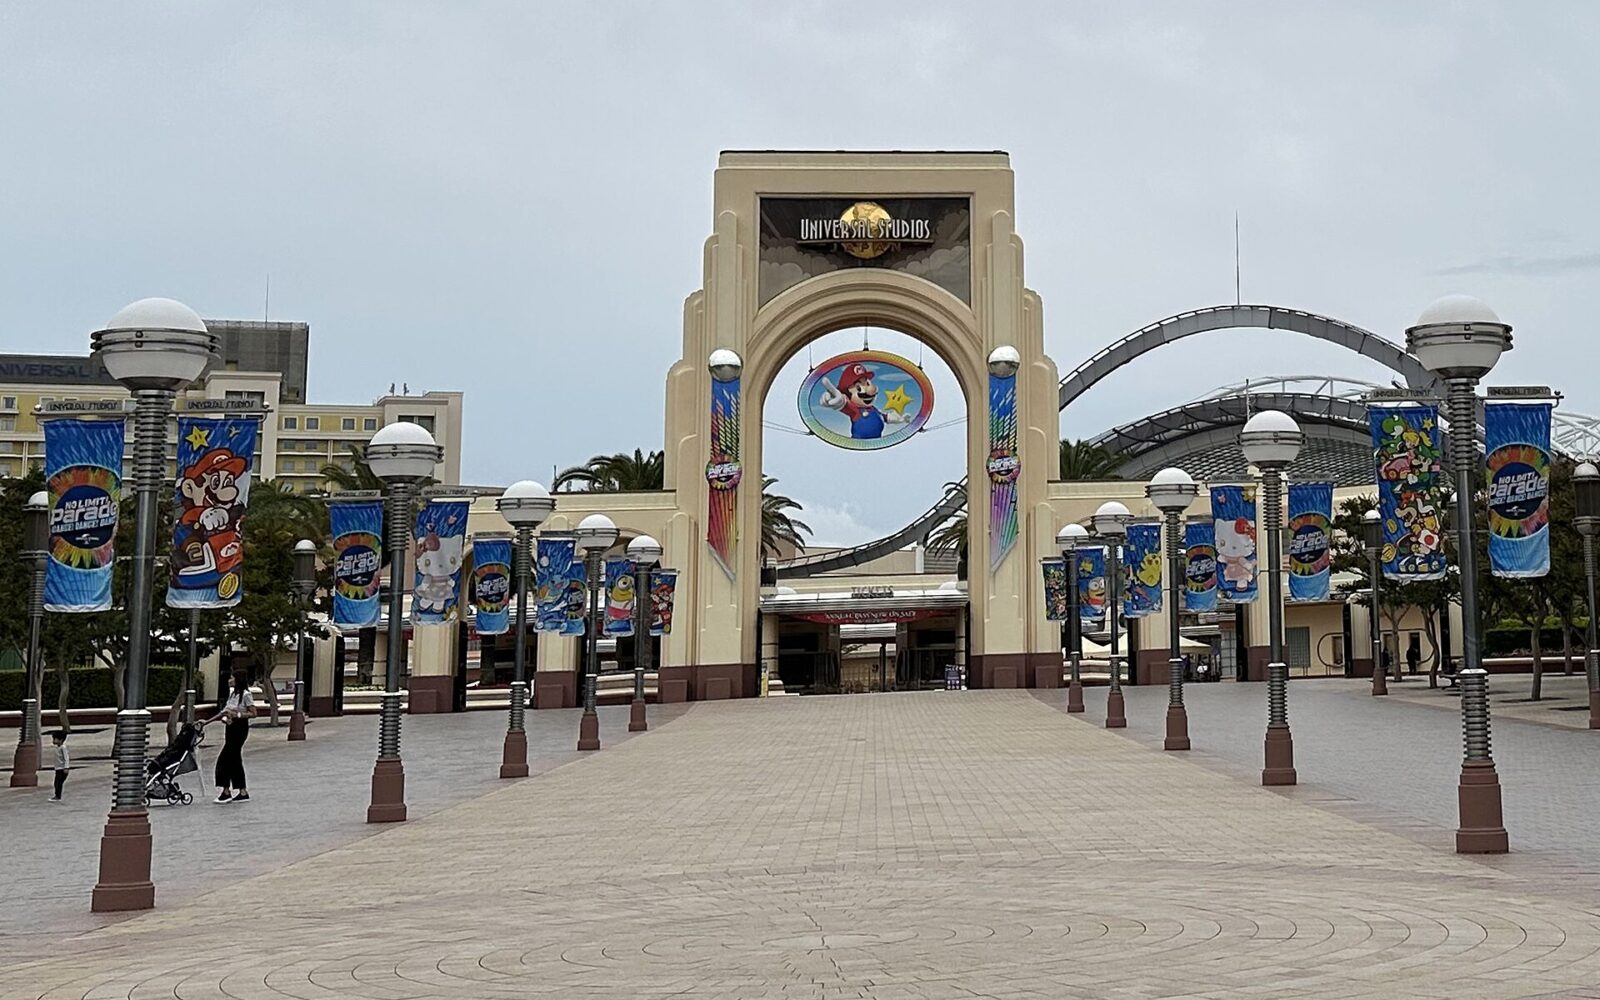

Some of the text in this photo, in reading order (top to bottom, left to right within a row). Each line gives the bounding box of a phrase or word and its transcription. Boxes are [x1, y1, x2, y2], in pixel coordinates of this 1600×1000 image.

[800, 218, 931, 240] UNIVERSAL STUDIOS
[1489, 476, 1548, 498] Parade
[65, 496, 109, 510] NO LIMIT!
[851, 586, 894, 598] TICKETS
